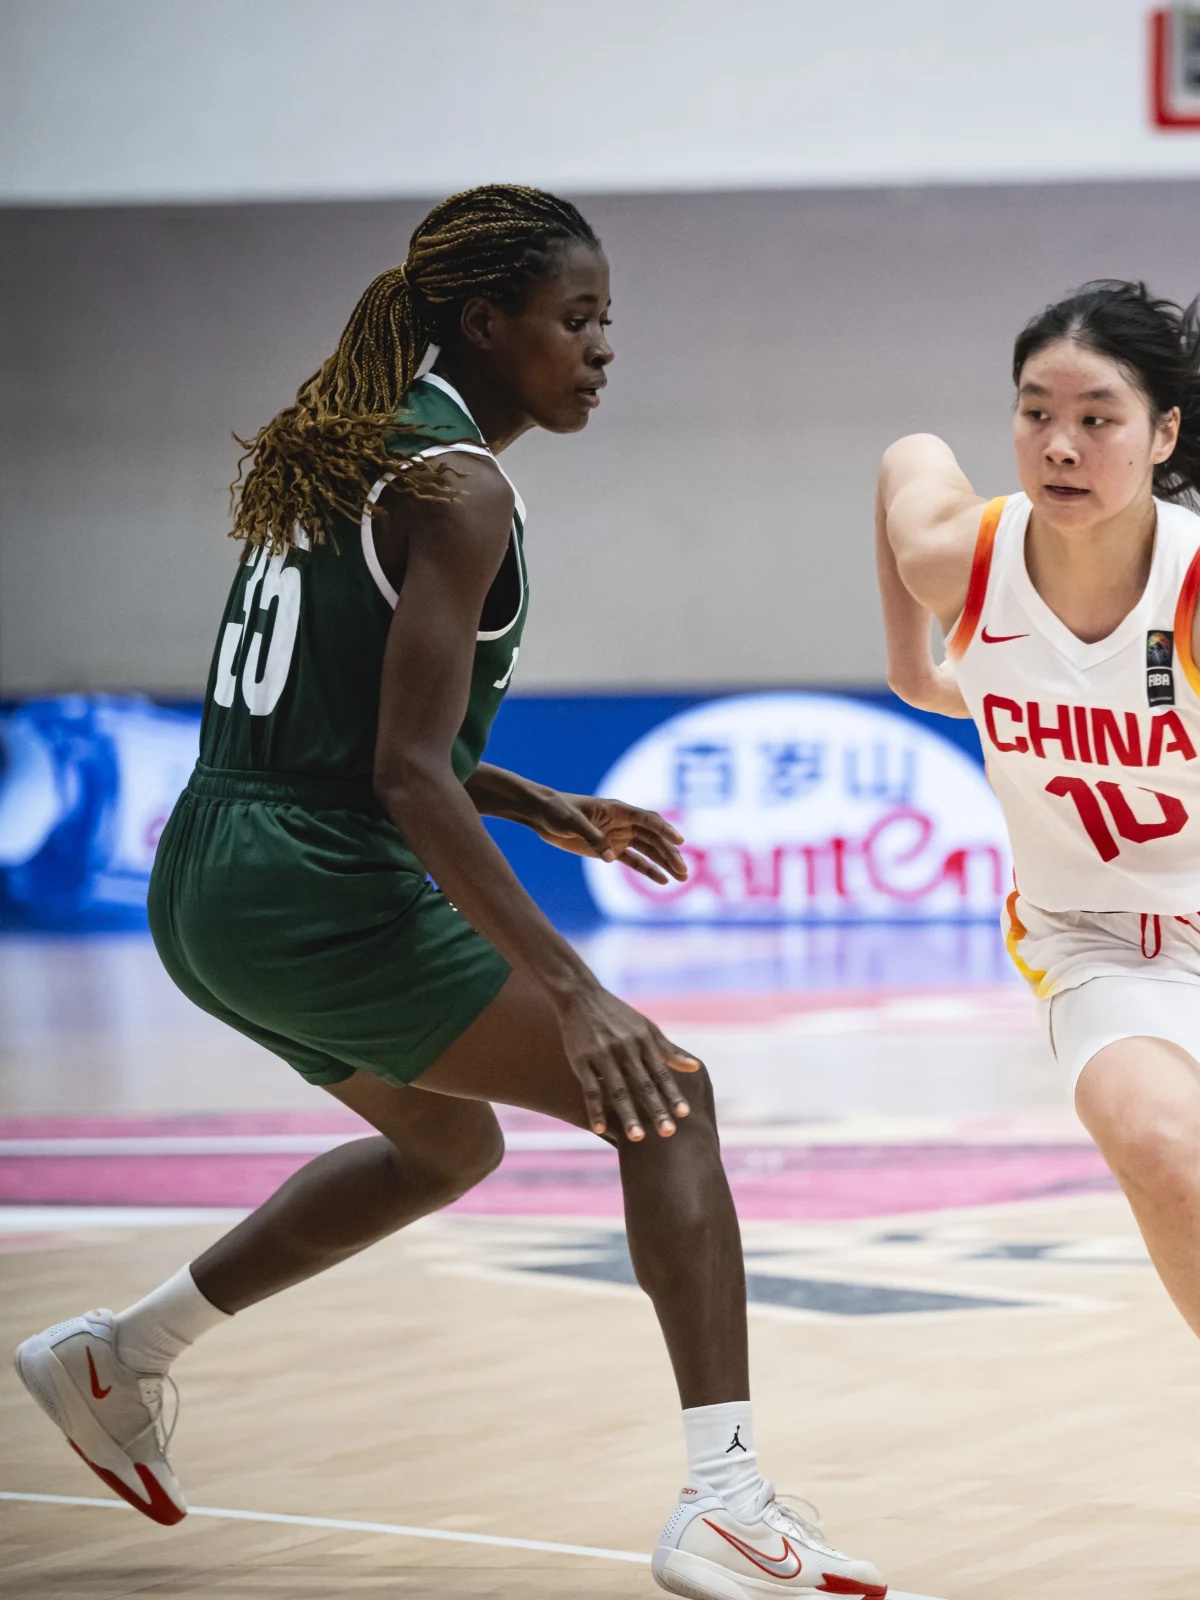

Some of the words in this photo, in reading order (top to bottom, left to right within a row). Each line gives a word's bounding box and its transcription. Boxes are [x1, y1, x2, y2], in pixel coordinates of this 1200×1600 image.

[1148, 673, 1171, 688] FIBA
[983, 693, 1198, 767] CHINA
[1044, 775, 1189, 863] 10
